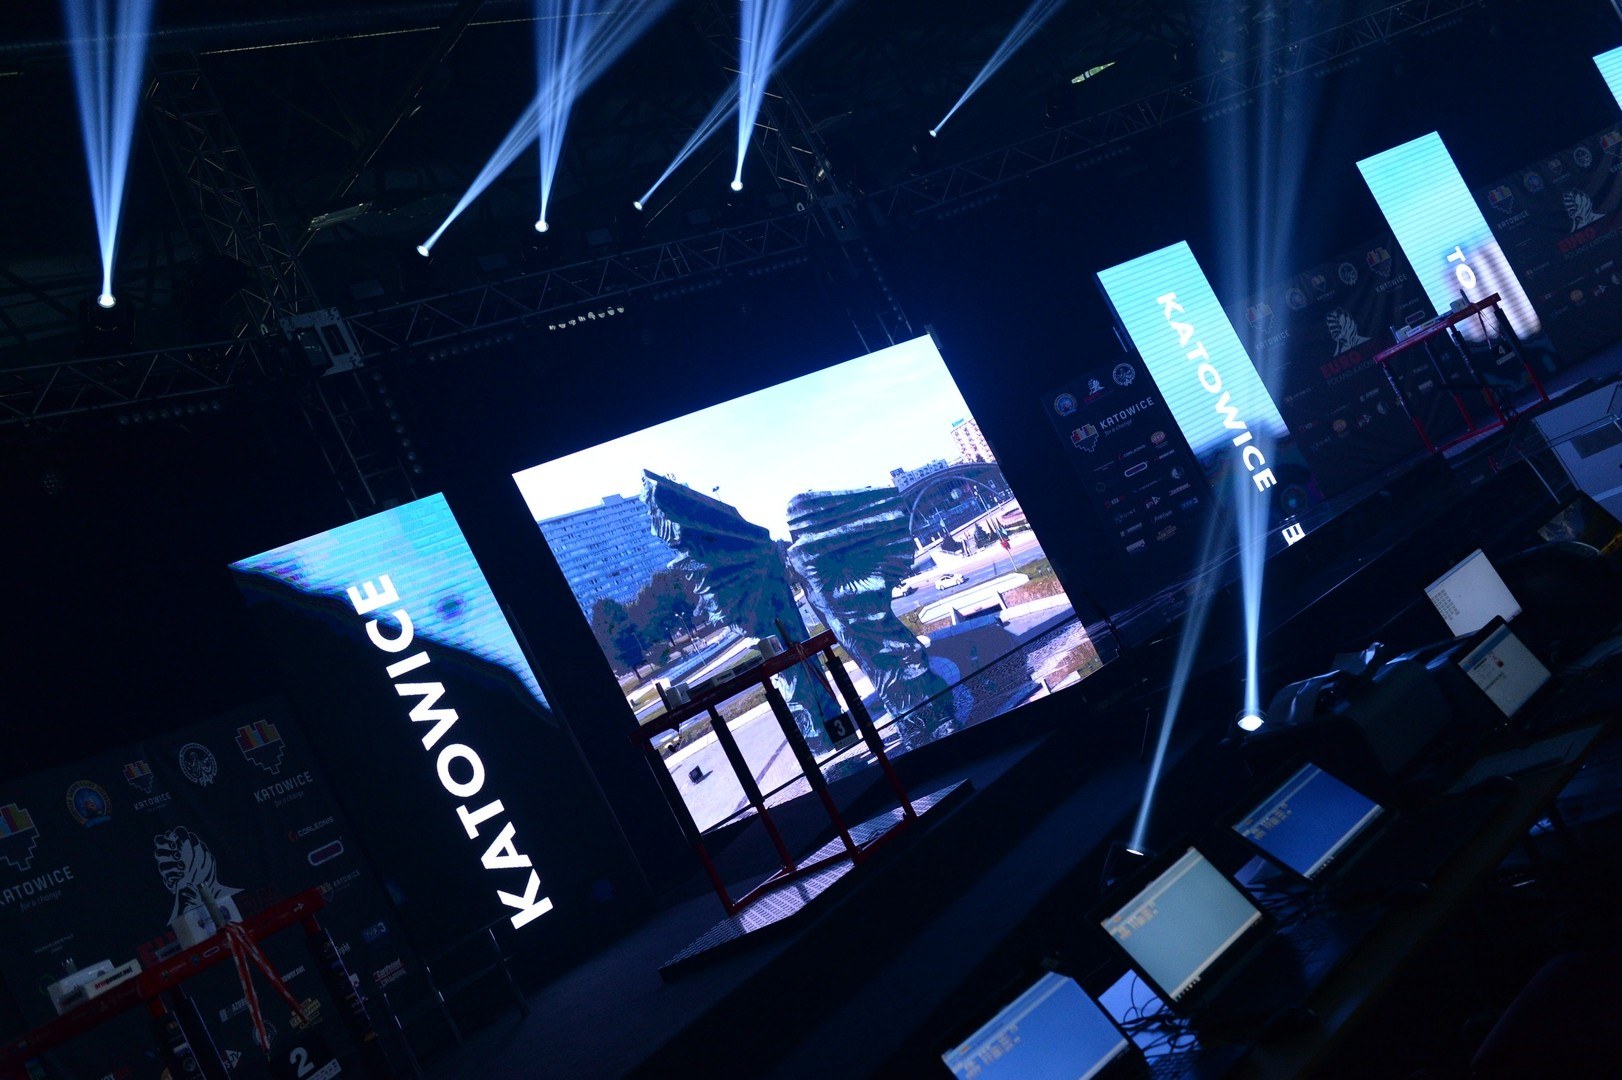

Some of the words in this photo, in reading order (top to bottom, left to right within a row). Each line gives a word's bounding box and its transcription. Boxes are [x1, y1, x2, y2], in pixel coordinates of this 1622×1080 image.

[1156, 291, 1278, 493] KATOWICE
[1098, 395, 1154, 430] KATOWICE
[834, 719, 846, 737] 3
[346, 574, 553, 929] KATOWICE
[133, 791, 172, 811] KATOWICE
[253, 771, 314, 804] KATOWICE
[331, 869, 361, 887] KATOWICE
[289, 1047, 315, 1079] 2
